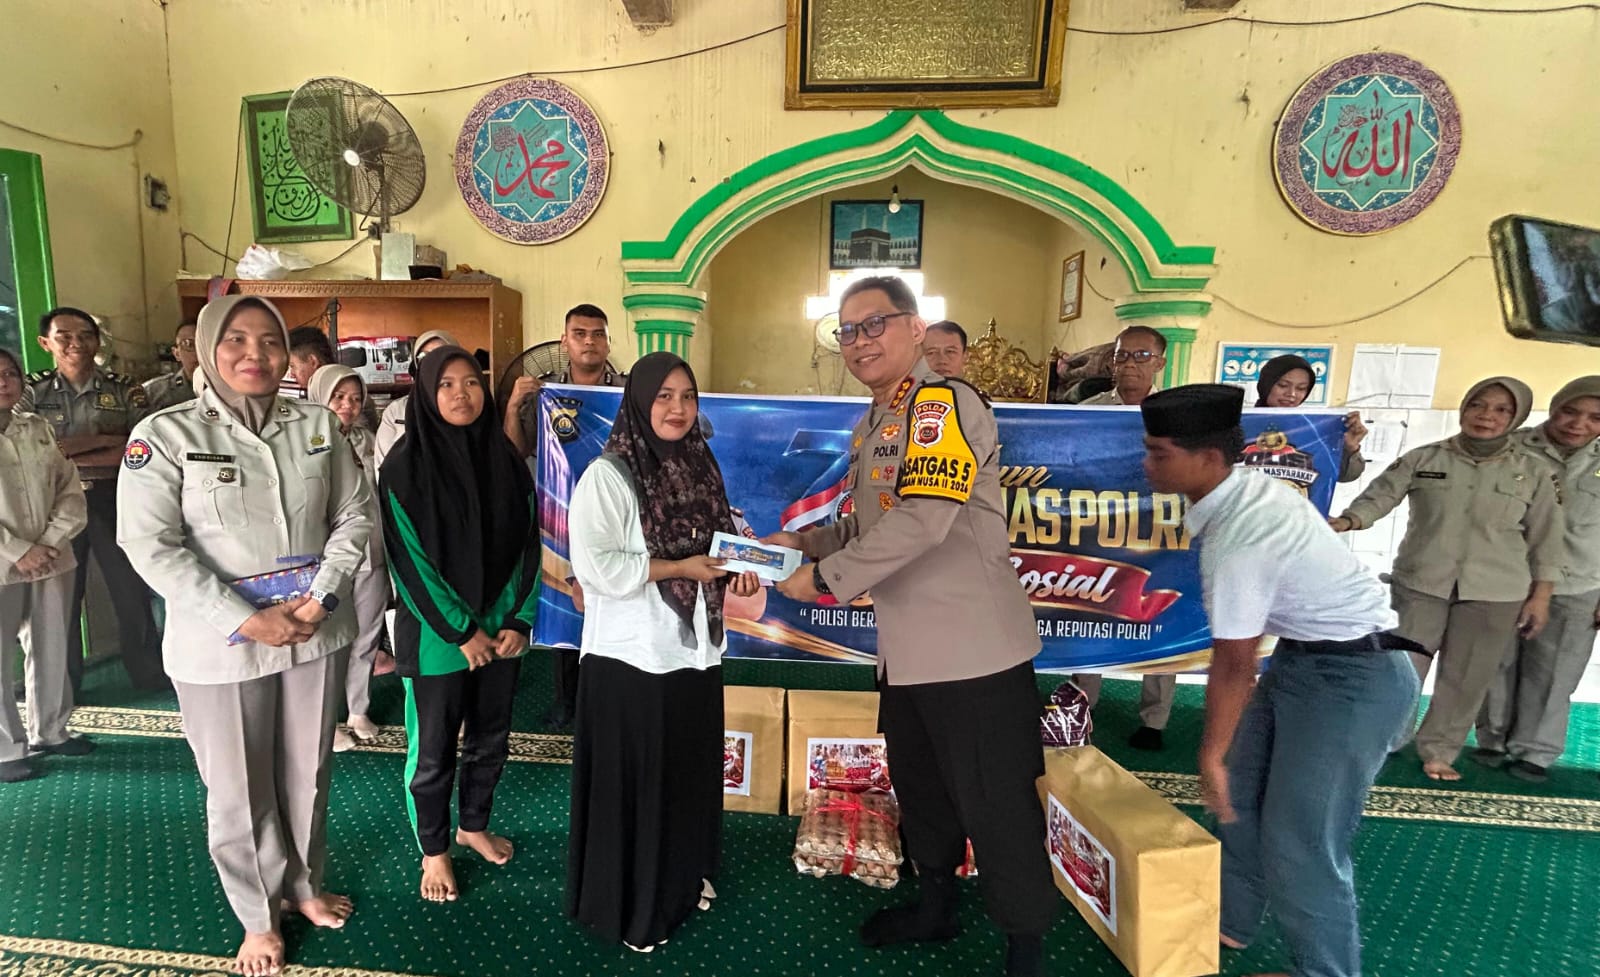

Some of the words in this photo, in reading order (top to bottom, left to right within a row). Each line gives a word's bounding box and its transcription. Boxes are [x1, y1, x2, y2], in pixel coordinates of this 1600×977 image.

[917, 404, 945, 414] POLDA
[873, 445, 898, 457] POLRI
[904, 457, 959, 478] SATGAS
[961, 462, 971, 482] 5
[1263, 467, 1313, 481] MASYARAKAT
[917, 477, 939, 488] NUSA
[811, 608, 848, 627] POLISI
[851, 610, 877, 628] BER
[1056, 620, 1113, 639] REPUTASI
[1117, 623, 1151, 641] POLRI
